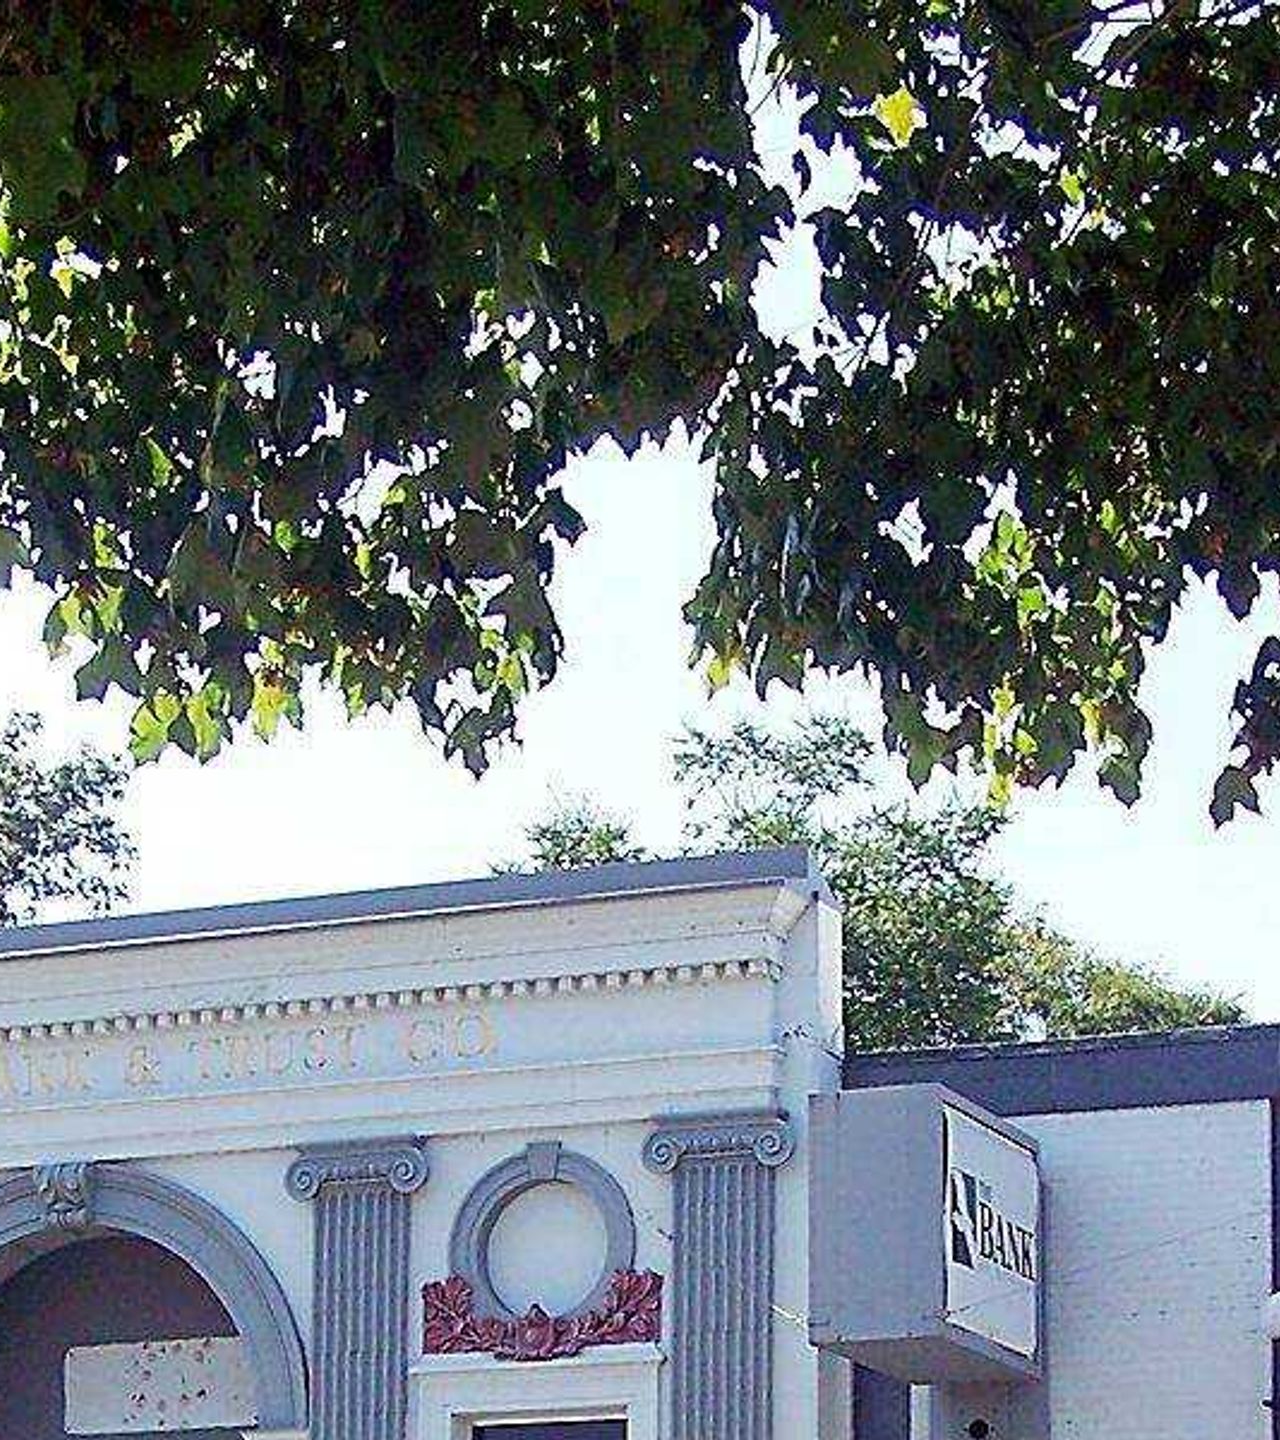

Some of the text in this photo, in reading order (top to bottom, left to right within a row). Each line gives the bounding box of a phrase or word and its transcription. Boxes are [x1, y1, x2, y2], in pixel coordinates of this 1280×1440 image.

[124, 1045, 163, 1087] &
[190, 1023, 367, 1078] TRUST
[979, 1200, 1038, 1282] BANK
